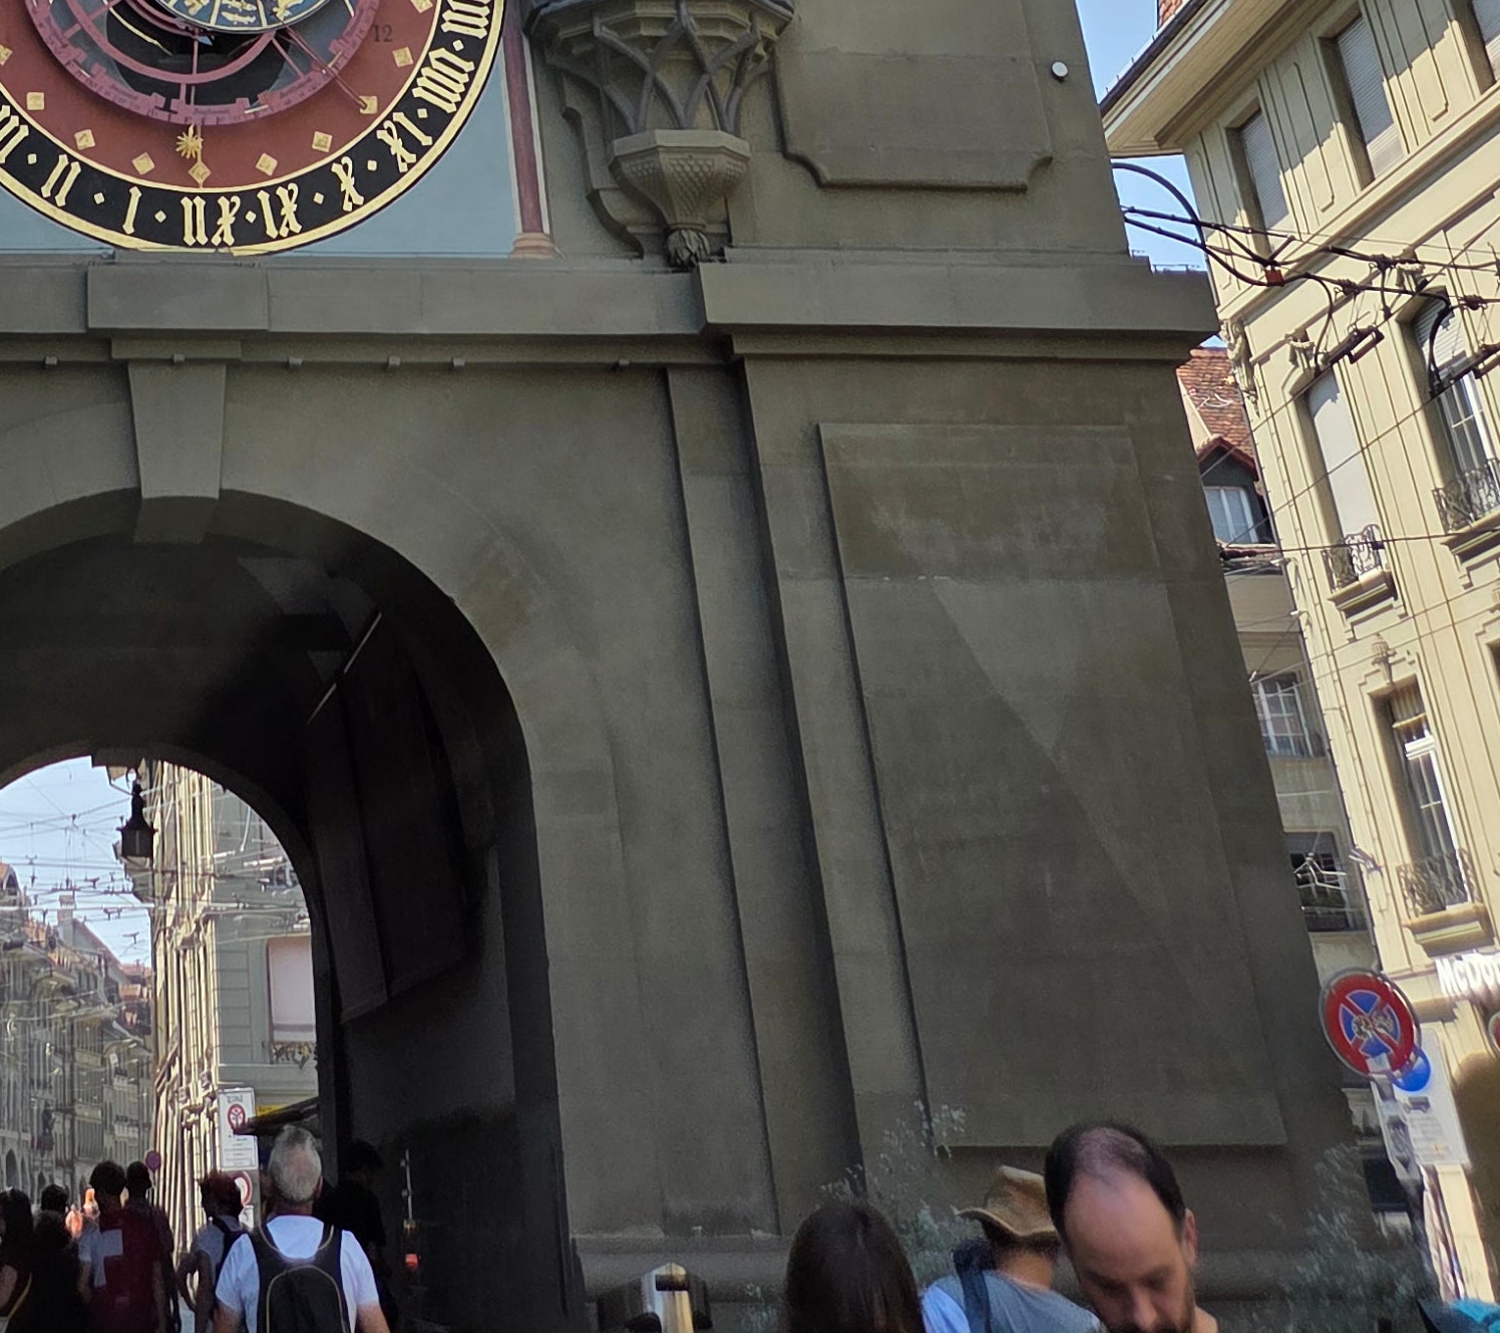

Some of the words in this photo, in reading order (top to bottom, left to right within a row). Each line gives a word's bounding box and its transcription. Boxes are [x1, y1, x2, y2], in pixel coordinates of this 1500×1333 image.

[373, 23, 394, 43] 12
[376, 111, 434, 173] IX
[40, 153, 82, 208] II
[331, 156, 365, 212] X
[122, 185, 142, 235] I
[180, 195, 242, 246] XII
[256, 182, 303, 239] XI
